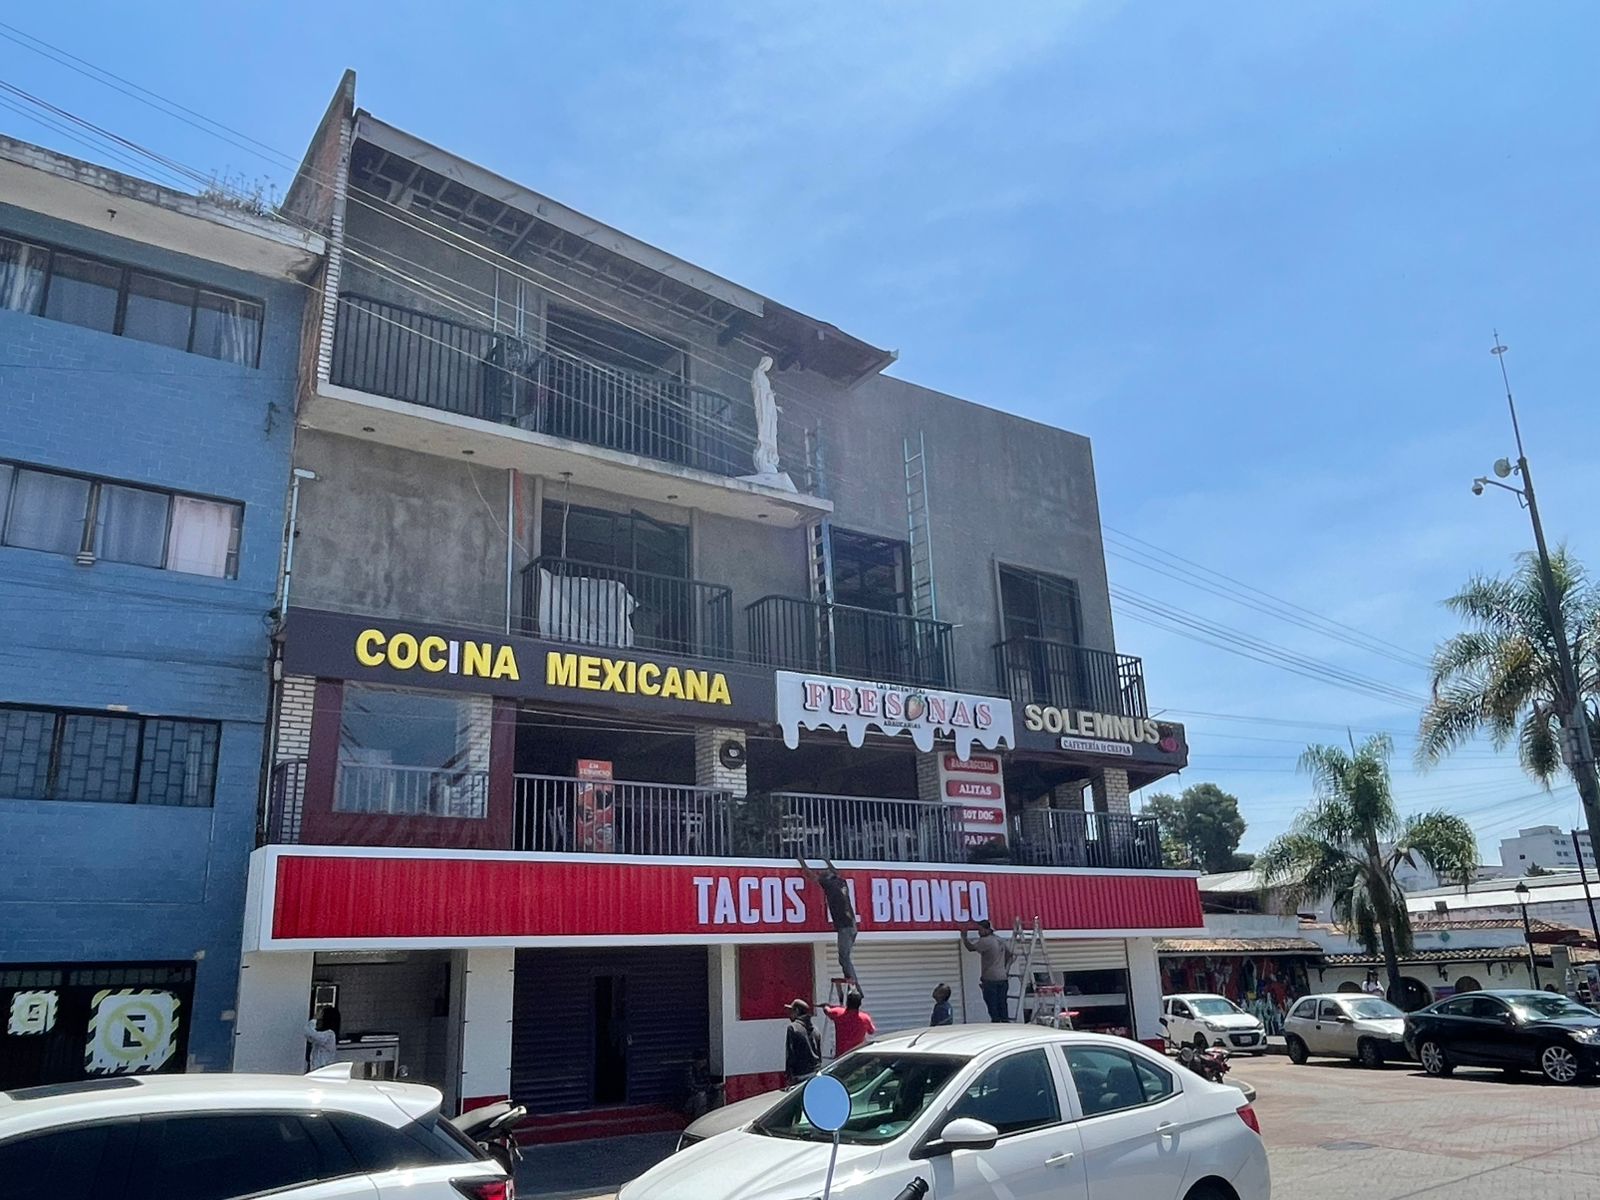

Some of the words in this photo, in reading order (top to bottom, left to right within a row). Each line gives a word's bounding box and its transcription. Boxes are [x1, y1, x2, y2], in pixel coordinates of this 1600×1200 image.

[355, 628, 520, 681] COCINA
[546, 651, 732, 705] MEXICANA
[1024, 703, 1160, 745] SOLEMNUS
[959, 783, 992, 796] ALITAS
[978, 810, 994, 821] DOG
[692, 875, 807, 925] TACOS
[827, 878, 861, 923] L
[871, 877, 989, 924] BRONCO
